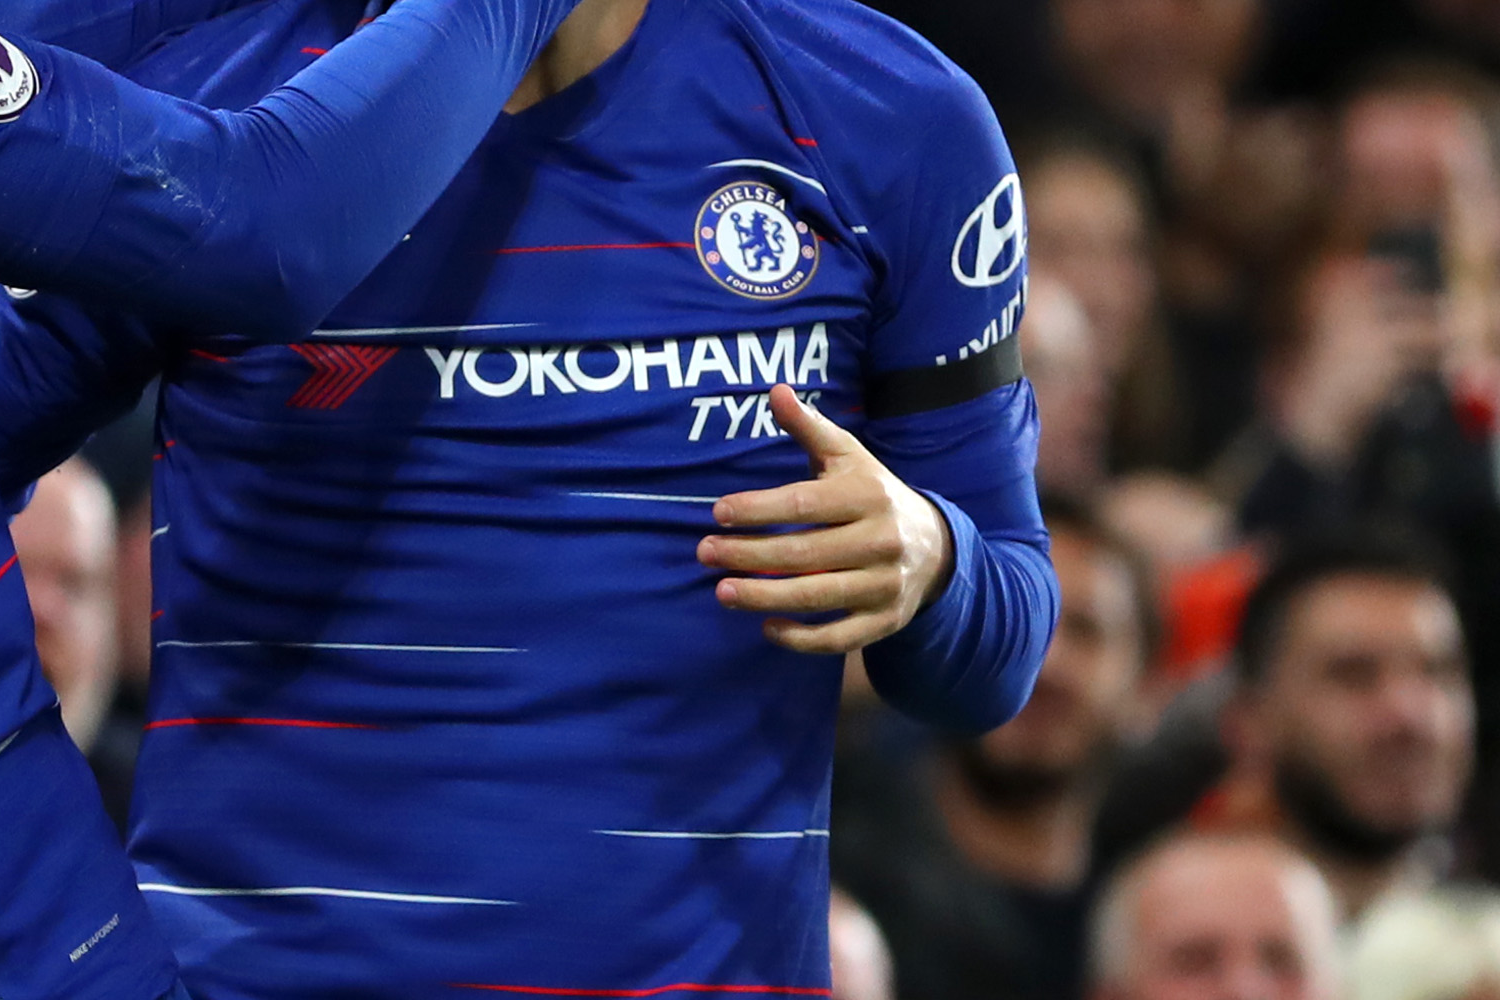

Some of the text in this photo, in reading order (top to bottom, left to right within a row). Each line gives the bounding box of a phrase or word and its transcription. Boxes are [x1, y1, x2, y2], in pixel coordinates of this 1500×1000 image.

[710, 186, 787, 214] CHELSEA
[726, 270, 805, 294] FOOTBALL CLUB
[424, 321, 829, 398] YOKOHAMA
